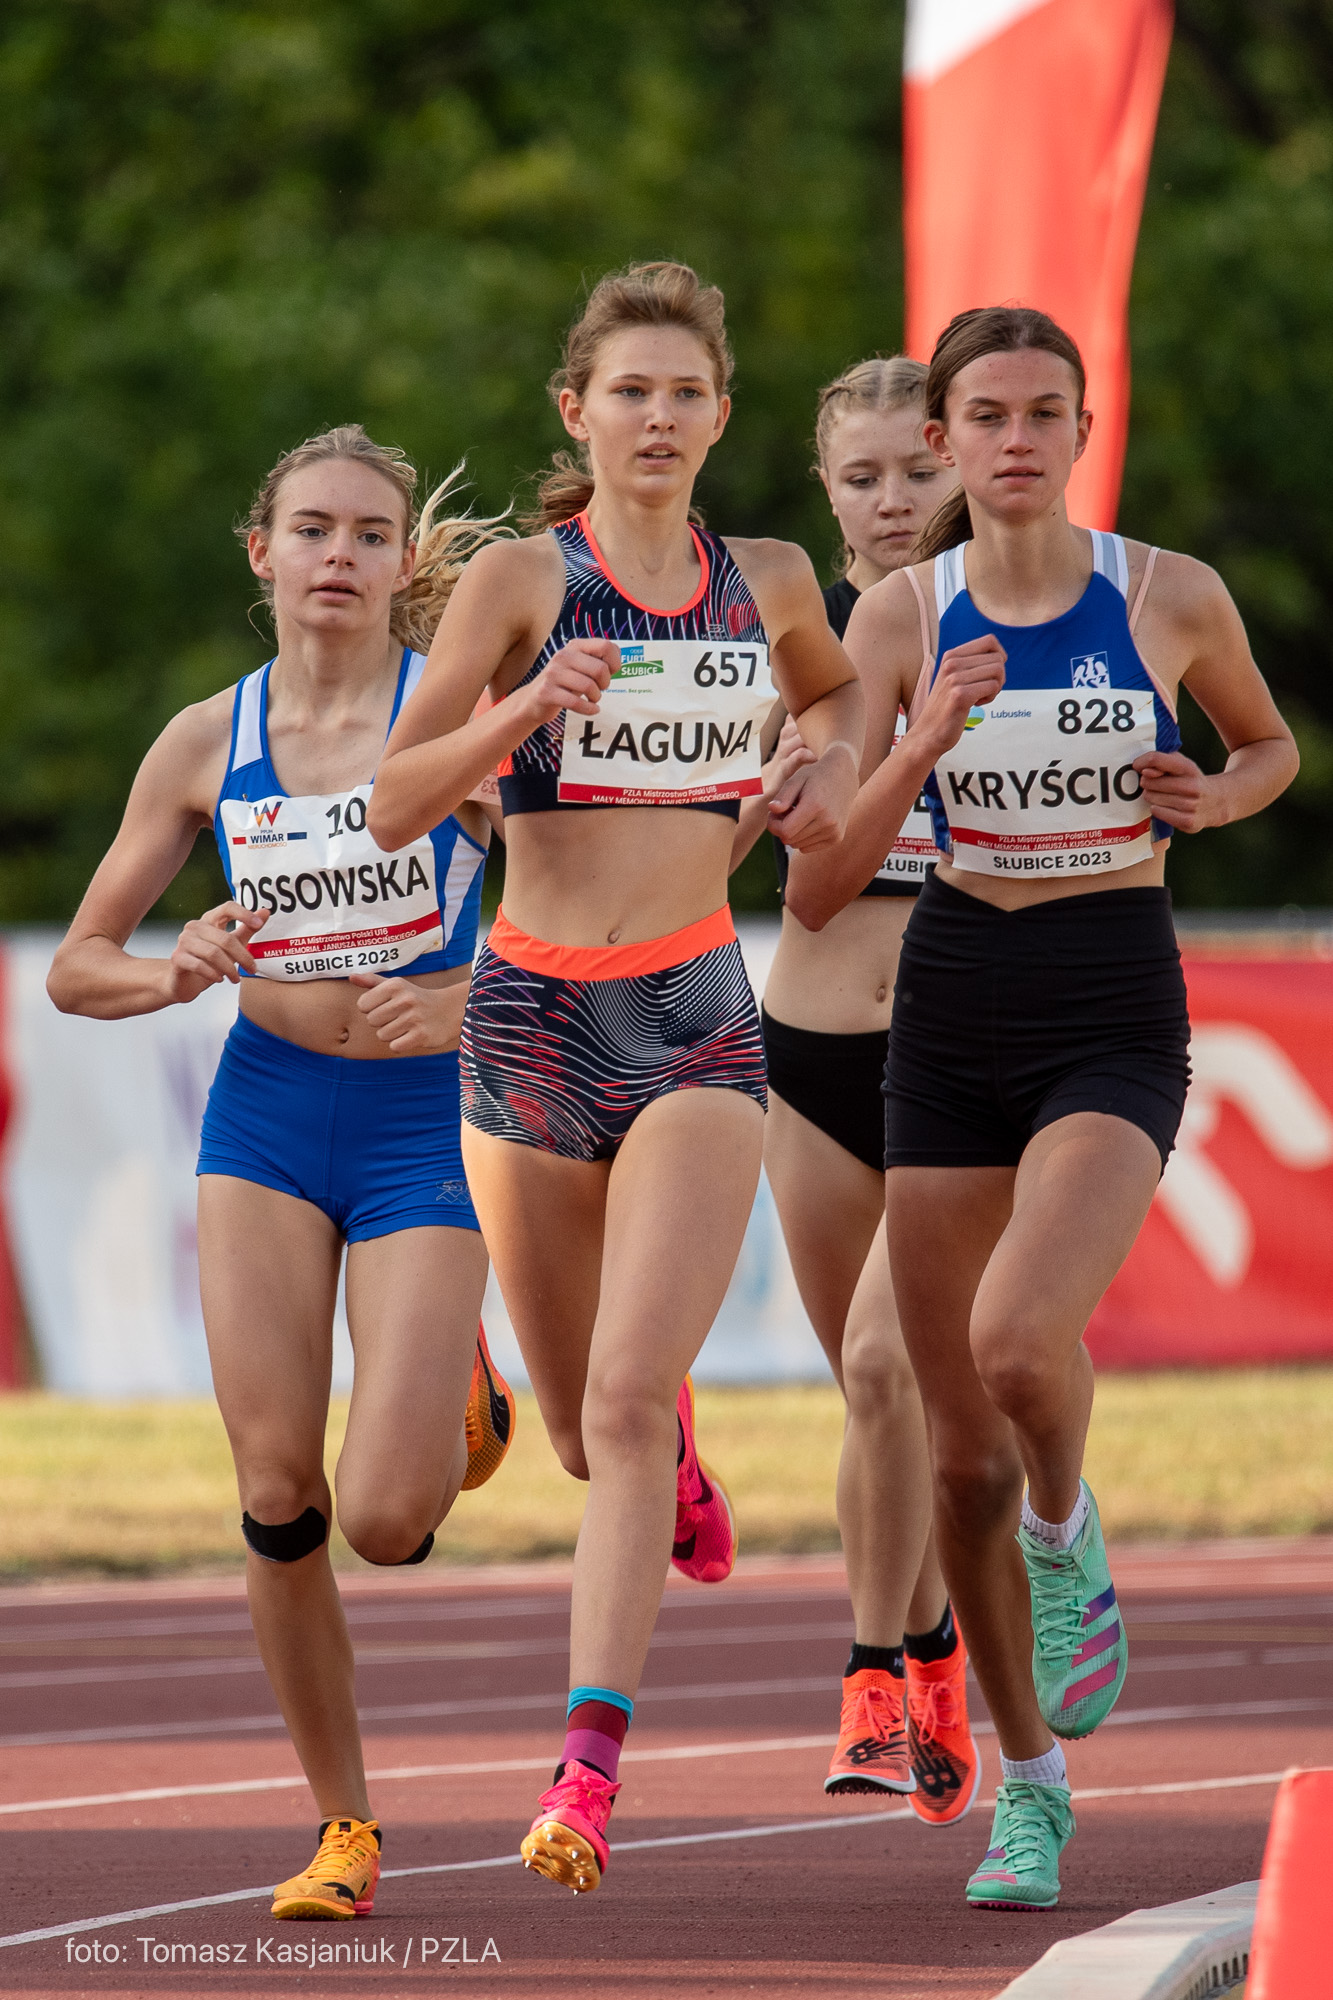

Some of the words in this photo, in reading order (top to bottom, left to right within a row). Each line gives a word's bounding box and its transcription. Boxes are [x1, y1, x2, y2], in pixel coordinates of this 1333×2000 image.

[621, 666, 658, 676] SŁUBICE
[693, 651, 758, 688] 657
[991, 708, 1032, 719] Lubuskie
[1057, 698, 1135, 735] 828
[578, 720, 753, 763] ŁAGUNA
[623, 788, 642, 797] PZLA
[643, 789, 687, 798] Mistrzostwa
[688, 786, 705, 797] Polski
[706, 784, 717, 794] U16
[947, 759, 1144, 811] KRYŚCIO
[592, 795, 614, 803] MAŁY
[325, 797, 367, 839] 10
[250, 833, 284, 844] WIMAR
[977, 839, 993, 848] MAŁY
[994, 842, 1031, 851] MEMORIAŁ
[1033, 841, 1068, 851] JANUSZA
[1070, 835, 1131, 848] KUSOCIŃSKIEGO
[999, 835, 1015, 844] PZLA
[1017, 833, 1063, 843] Mistrzostwa
[1065, 831, 1087, 841] Polski
[1089, 829, 1102, 838] U16
[993, 855, 1064, 870] SŁUBICE
[1069, 851, 1112, 868] 2023
[240, 855, 430, 915] OSSOWSKA
[263, 949, 283, 958] MAŁY
[284, 945, 321, 956] MEMORIAŁ
[322, 941, 356, 951] JANUSZA
[357, 929, 417, 947] KUSOCIŃSKIEGO
[289, 937, 306, 947] PZLA
[307, 934, 350, 945] Mistrzostwa
[351, 929, 373, 939] Polski
[374, 927, 389, 936] U16
[284, 955, 354, 975] SŁUBICE
[357, 948, 399, 966] 2023
